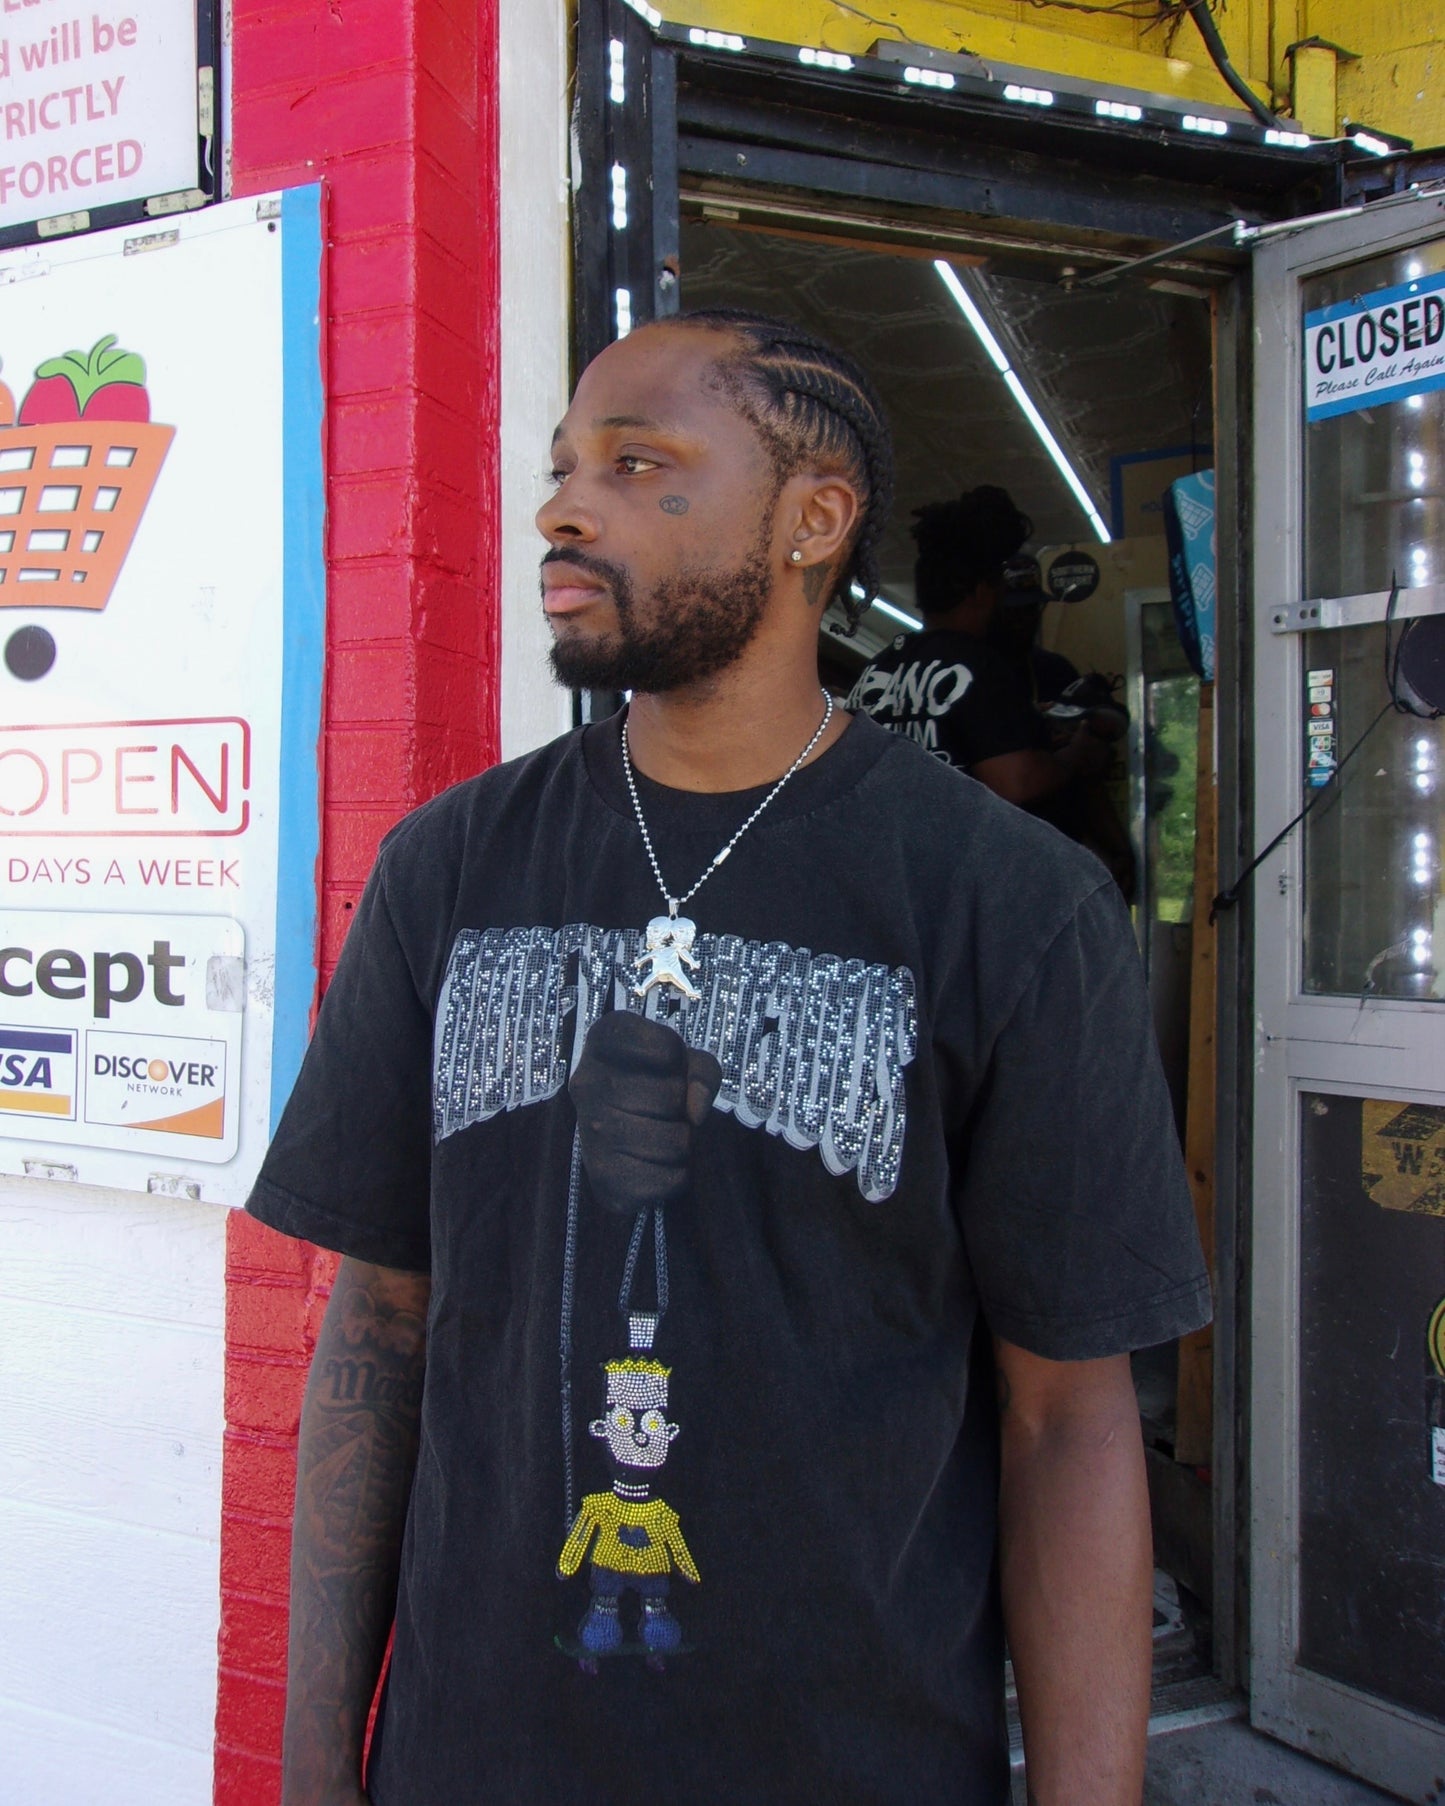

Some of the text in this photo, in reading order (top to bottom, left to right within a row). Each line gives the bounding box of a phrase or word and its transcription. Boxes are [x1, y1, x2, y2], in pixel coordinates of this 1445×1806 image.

[20, 20, 80, 71] will
[93, 15, 137, 54] be
[0, 76, 126, 140] RICTLY
[0, 139, 143, 204] FORCED
[1316, 295, 1445, 374] CLOSED
[1316, 357, 1444, 397] Please Call Again
[1313, 723, 1330, 731] VISA
[0, 742, 229, 816] OPEN
[9, 858, 240, 887] DAYS A WEEK
[0, 941, 186, 1018] cept
[94, 1055, 216, 1087] DISCOVER
[127, 1083, 183, 1097] NETWORK
